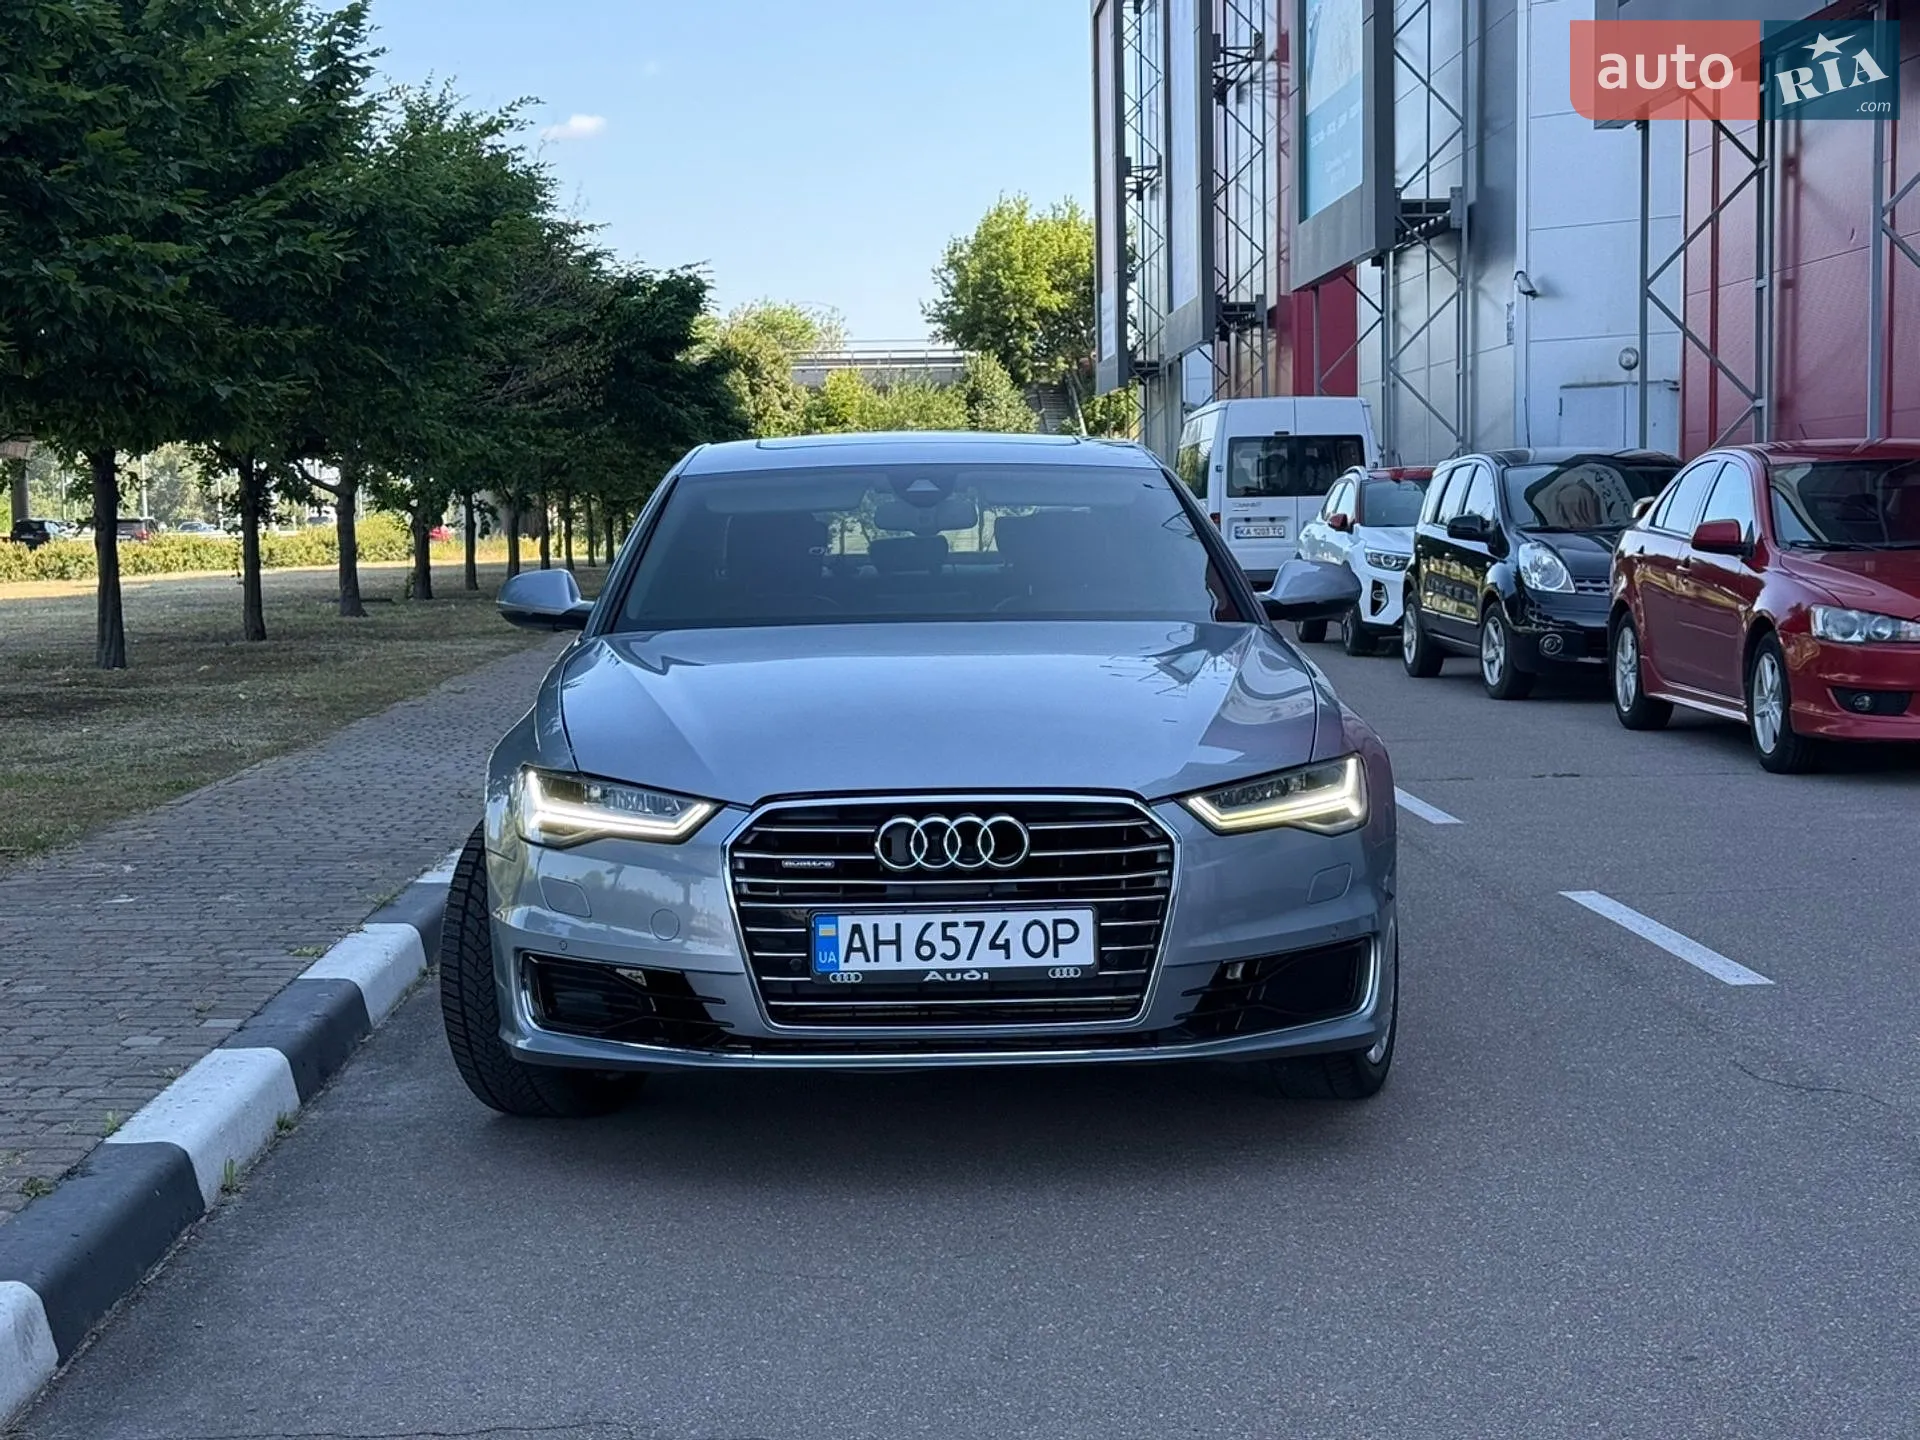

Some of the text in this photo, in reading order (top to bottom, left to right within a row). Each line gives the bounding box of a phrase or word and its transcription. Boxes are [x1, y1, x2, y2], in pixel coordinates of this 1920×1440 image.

[843, 918, 1080, 964] AH 6574 OP
[818, 951, 837, 964] UA
[923, 970, 989, 982] Audi
